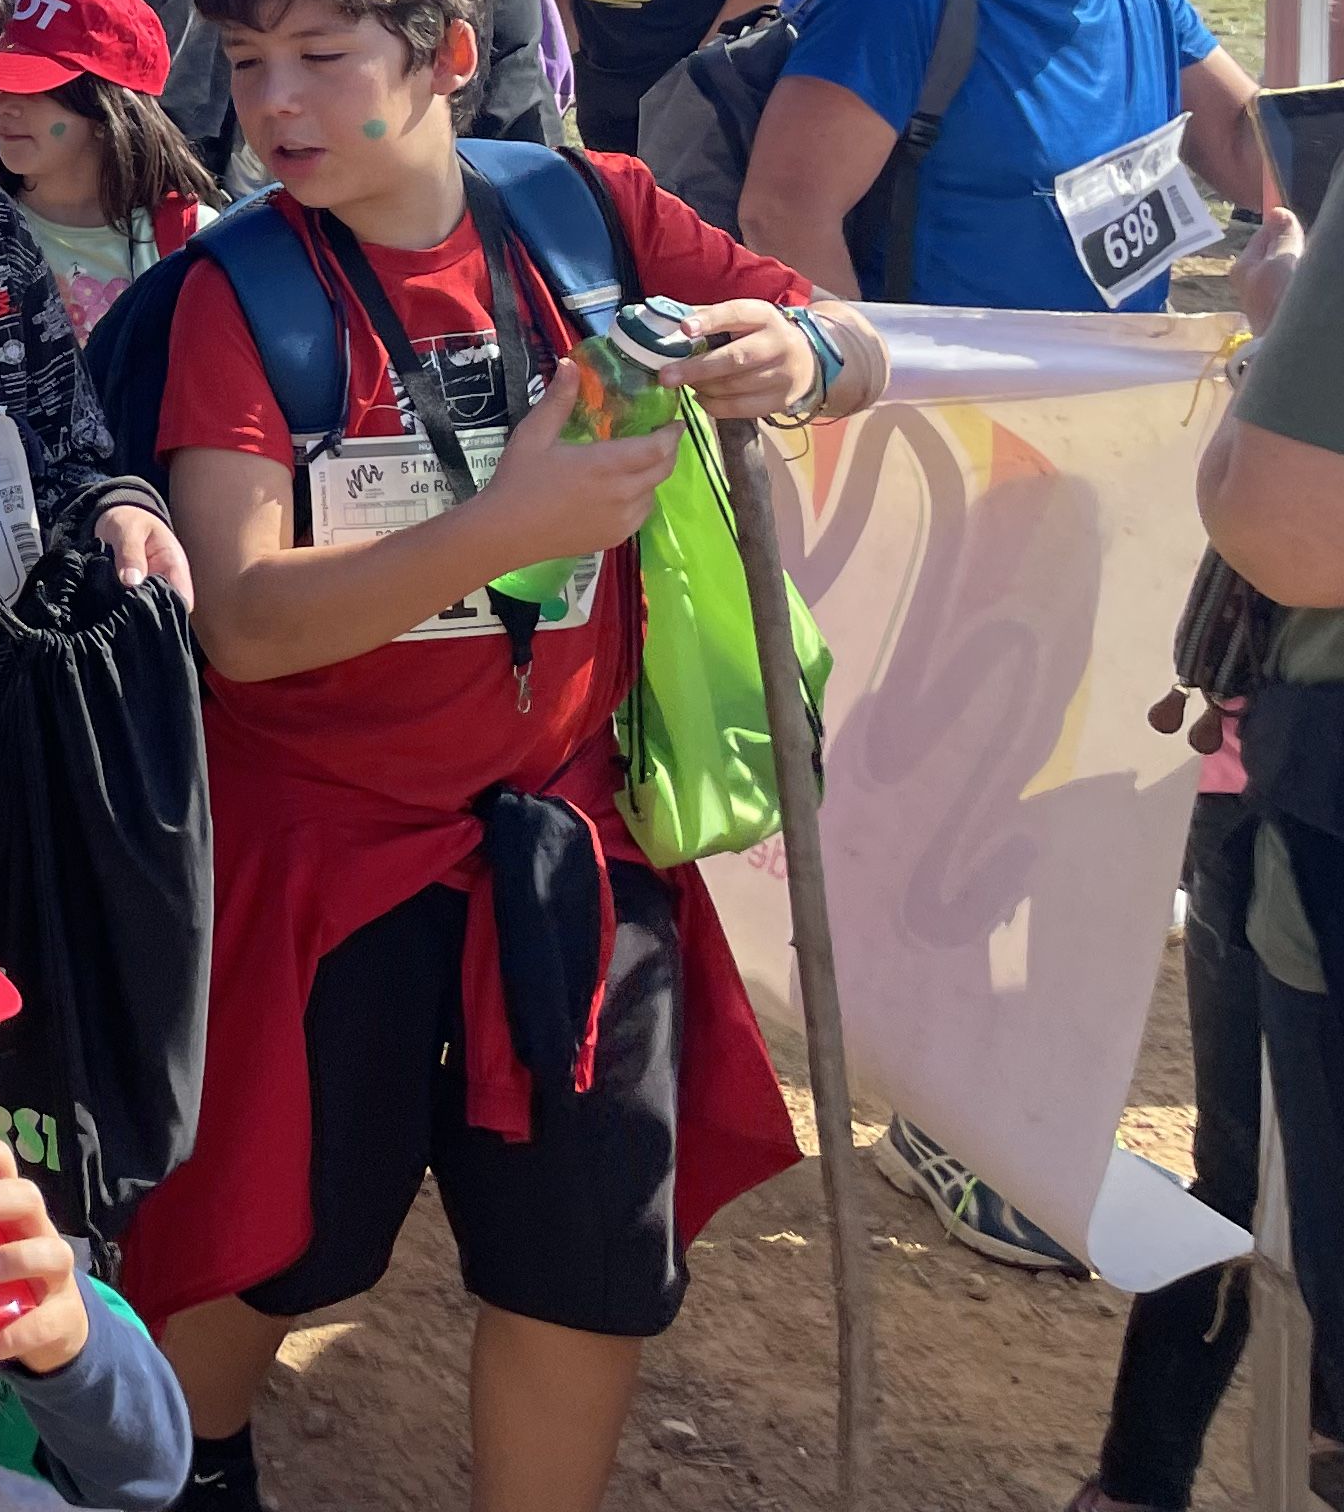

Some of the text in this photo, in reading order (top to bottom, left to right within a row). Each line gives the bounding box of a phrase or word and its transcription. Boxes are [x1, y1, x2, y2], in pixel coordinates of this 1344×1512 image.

[1103, 200, 1159, 270] 698
[400, 460, 418, 475] 51
[410, 479, 431, 495] de
